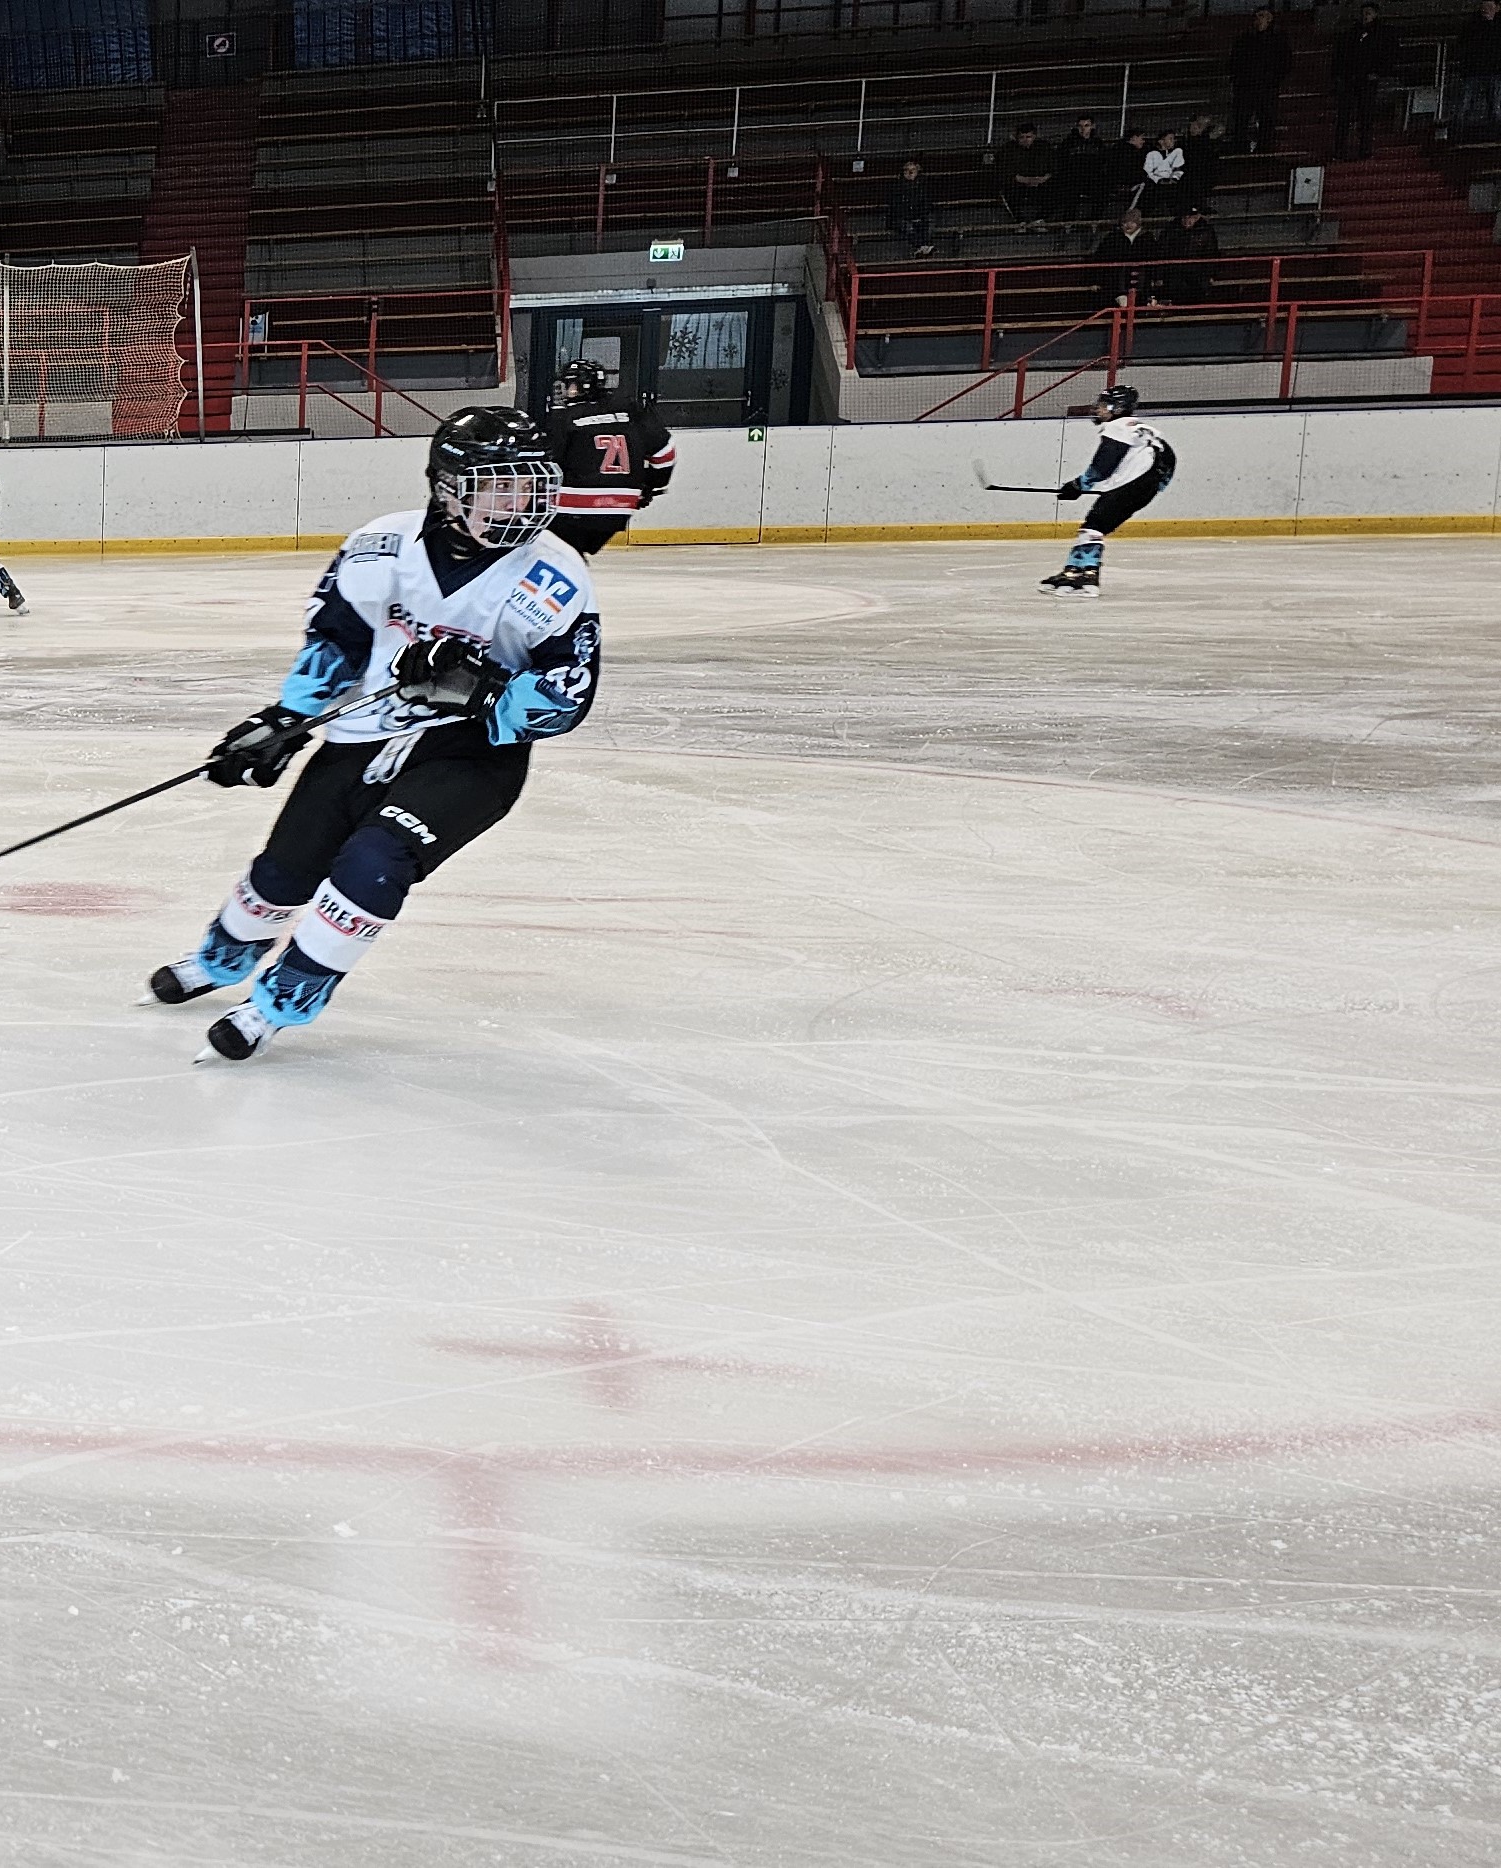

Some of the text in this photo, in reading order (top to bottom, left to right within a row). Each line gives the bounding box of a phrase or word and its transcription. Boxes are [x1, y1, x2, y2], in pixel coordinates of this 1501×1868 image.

[593, 434, 631, 475] 21
[511, 588, 528, 605] VR
[525, 600, 555, 626] Bank
[379, 805, 438, 845] CCM
